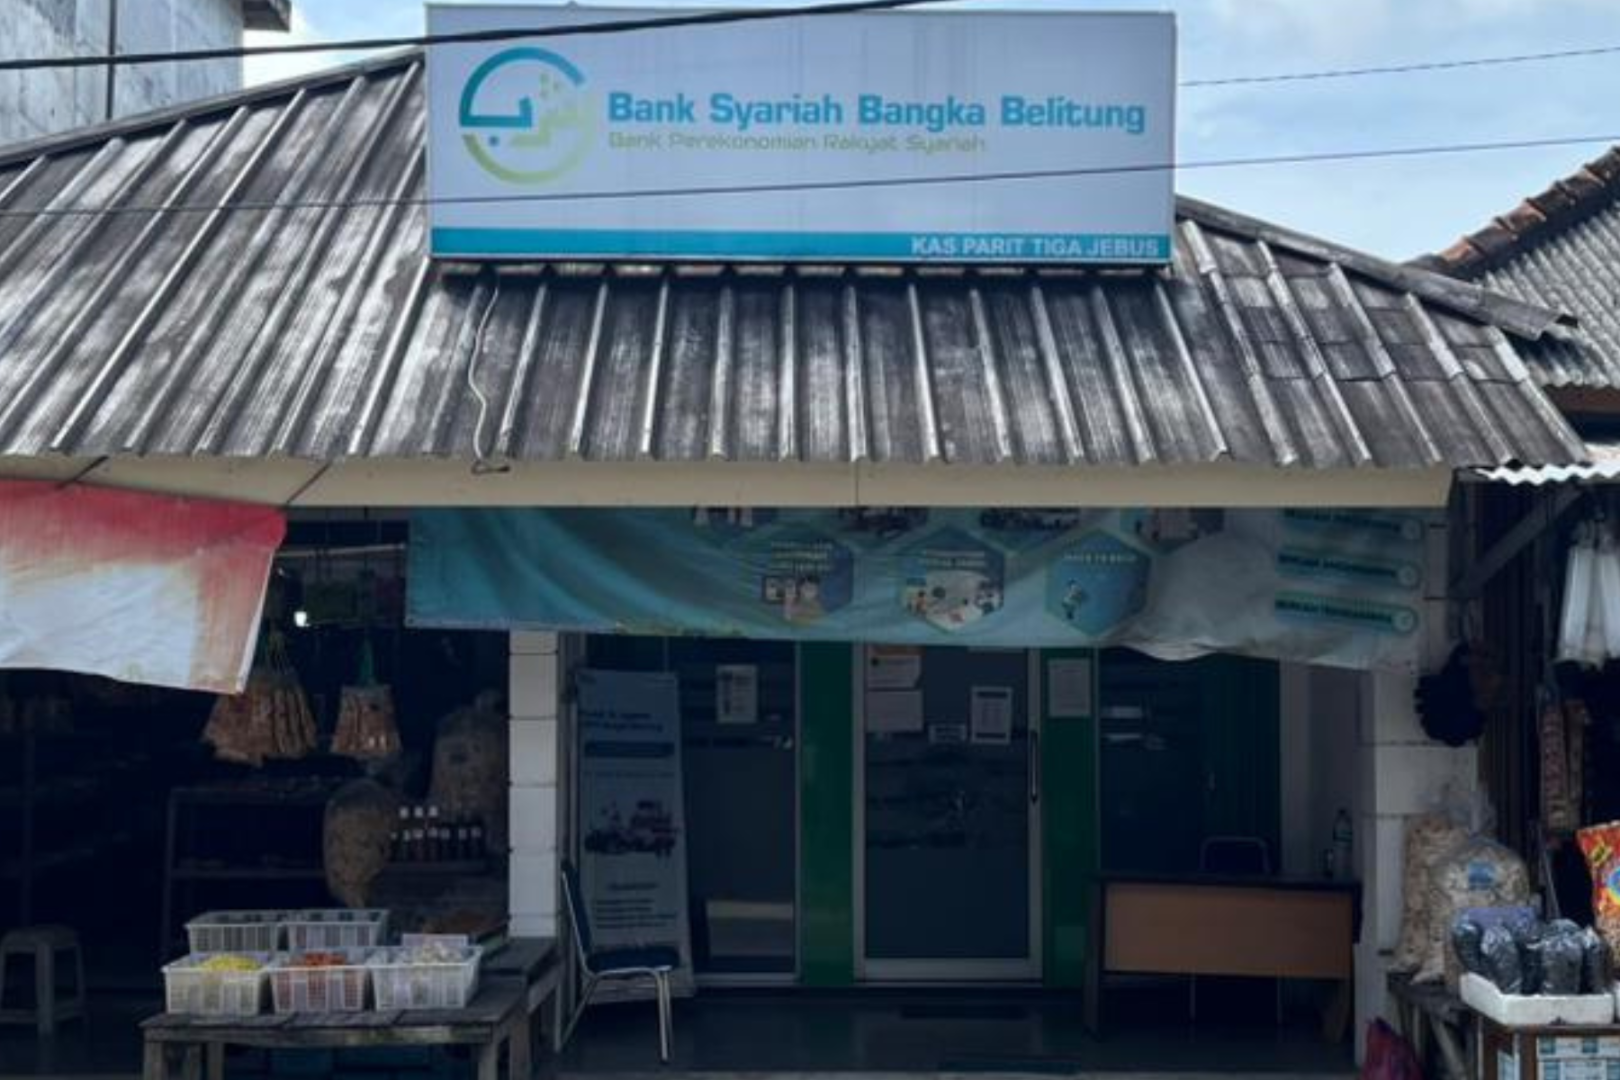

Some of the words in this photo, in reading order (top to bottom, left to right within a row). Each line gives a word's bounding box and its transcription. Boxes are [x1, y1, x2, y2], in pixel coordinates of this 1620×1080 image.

[609, 93, 695, 122] Bank
[710, 93, 843, 130] Syariah
[858, 94, 986, 132] Bangka
[1001, 96, 1147, 135] Belitung
[608, 132, 662, 148] Bank
[669, 133, 816, 150] Perekonomian
[824, 134, 899, 154] Rakyat
[906, 136, 986, 155] Syariah
[911, 236, 956, 254] KAS
[963, 237, 1026, 255] PARIT
[1033, 238, 1083, 256] TIGA
[1086, 239, 1159, 257] JEBUS
